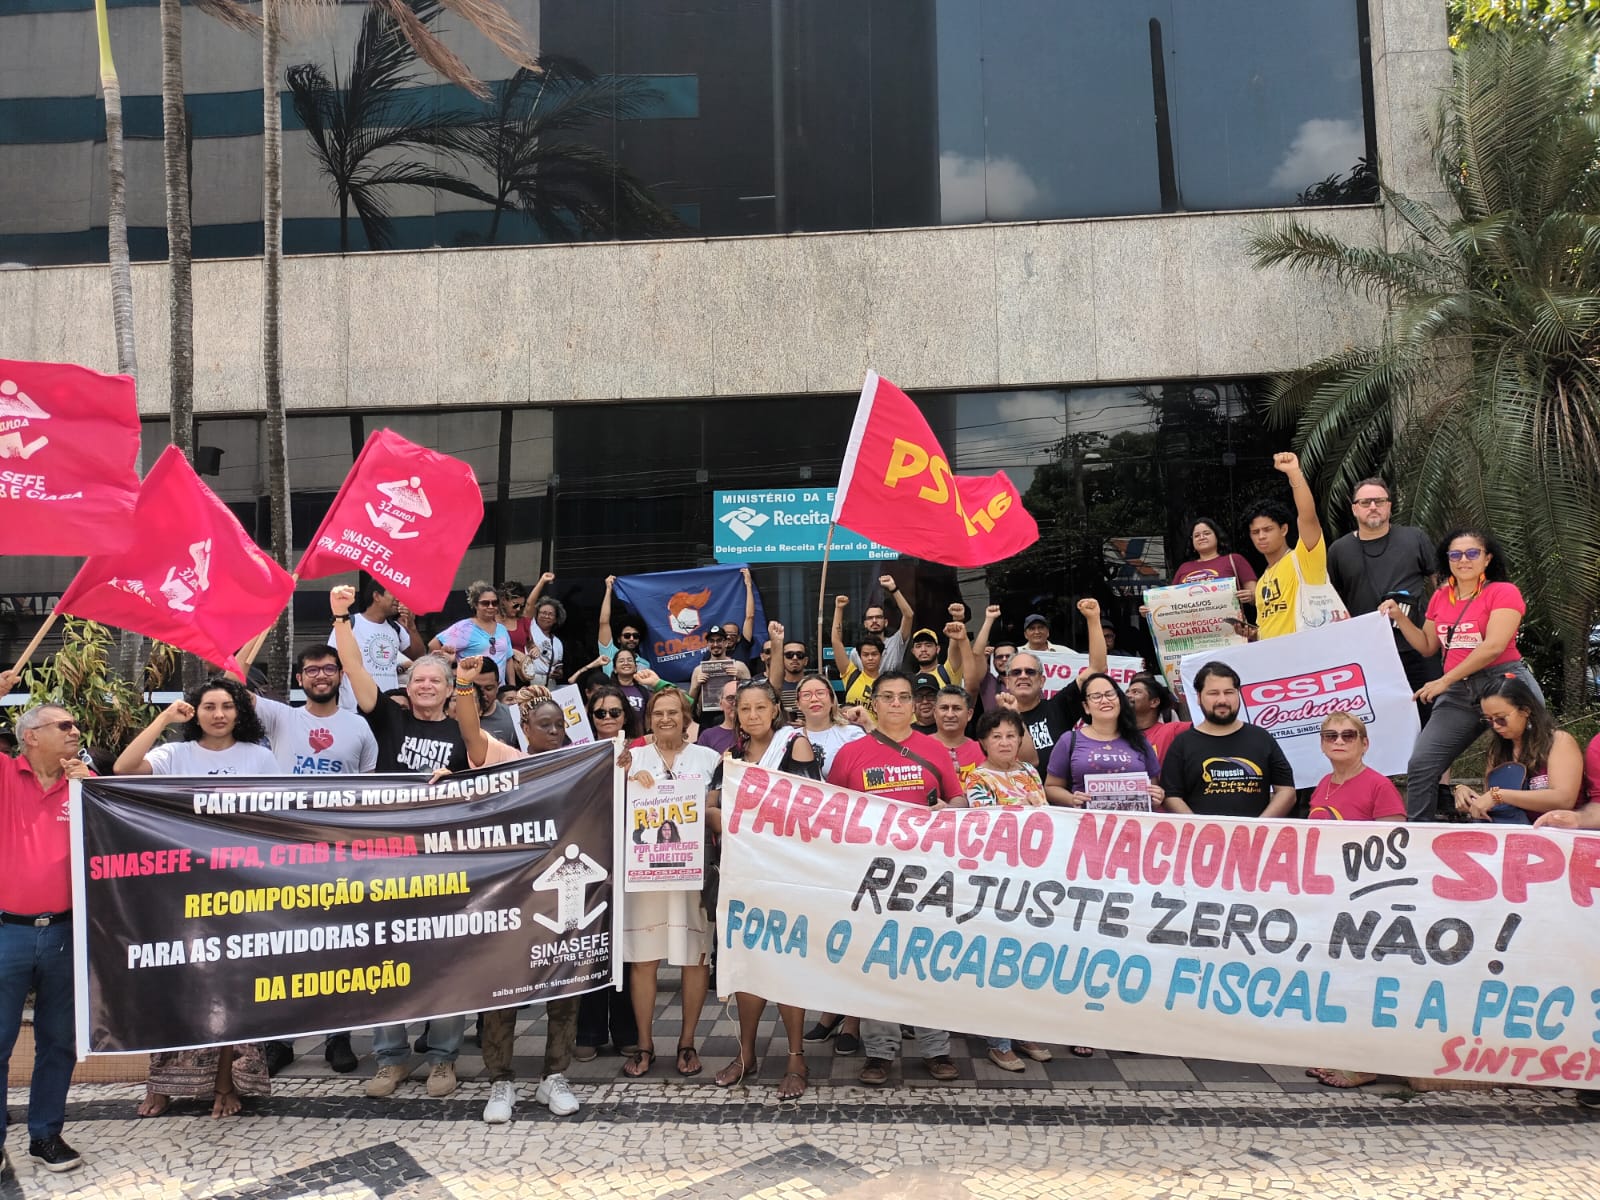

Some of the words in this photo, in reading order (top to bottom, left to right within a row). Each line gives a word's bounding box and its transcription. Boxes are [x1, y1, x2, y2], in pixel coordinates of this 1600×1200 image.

[722, 493, 796, 504] MINISTÉRIO
[803, 493, 820, 502] DA
[773, 510, 830, 526] Receita
[715, 544, 762, 555] Delegacia
[765, 544, 777, 553] da
[779, 542, 815, 552] Receita
[856, 541, 868, 550] do
[868, 551, 899, 559] Belém
[372, 560, 412, 589] CIABA
[1169, 626, 1213, 638] SALARIAL
[1251, 669, 1354, 703] CSP
[1254, 695, 1367, 729] Conlutas
[886, 765, 922, 774] Vamos
[1094, 753, 1127, 762] PSTU
[193, 791, 308, 814] PARTICIPE
[313, 790, 356, 809] DAS
[634, 801, 698, 830] RUAS
[728, 767, 1054, 871] PARALISAÇÃO
[1065, 812, 1335, 896] NACIONAL
[1341, 826, 1411, 882] DOS
[90, 848, 191, 880] SINASEFE
[210, 846, 264, 870] IFPA,
[270, 843, 329, 866] CTRB
[334, 841, 347, 863] E
[351, 836, 418, 862] CIABA
[424, 831, 452, 854] NA
[456, 826, 506, 851] LUTA
[510, 819, 558, 845] PELA
[649, 852, 694, 863] DIREITOS
[184, 877, 365, 919] RECOMPOSIÇÃO
[370, 871, 470, 902] SALARIAL
[851, 857, 1135, 939] REAJUSTE
[1146, 891, 1312, 963] ZERO,
[128, 940, 186, 969] PARA
[190, 937, 221, 964] AS
[226, 923, 369, 960] SERVIDORAS
[375, 922, 387, 945] E
[391, 907, 522, 943] SERVIDORES
[530, 931, 609, 960] SINASEFE
[553, 953, 576, 964] CTRB
[578, 951, 585, 960] E
[586, 946, 609, 958] CIABA
[255, 975, 287, 1003] DA
[291, 960, 411, 999] EDUCAÇÃO
[492, 989, 514, 998] saiba
[515, 986, 534, 994] mais
[534, 982, 549, 990] em:
[550, 968, 609, 988] sinasefepa.org.br
[726, 899, 809, 959] FORA
[826, 919, 852, 964] O
[861, 919, 1152, 1012] ARCABOUÇO
[1164, 957, 1348, 1023] FISCAL
[1371, 976, 1400, 1028] E
[1415, 980, 1448, 1033] A
[1472, 979, 1575, 1041] PEC
